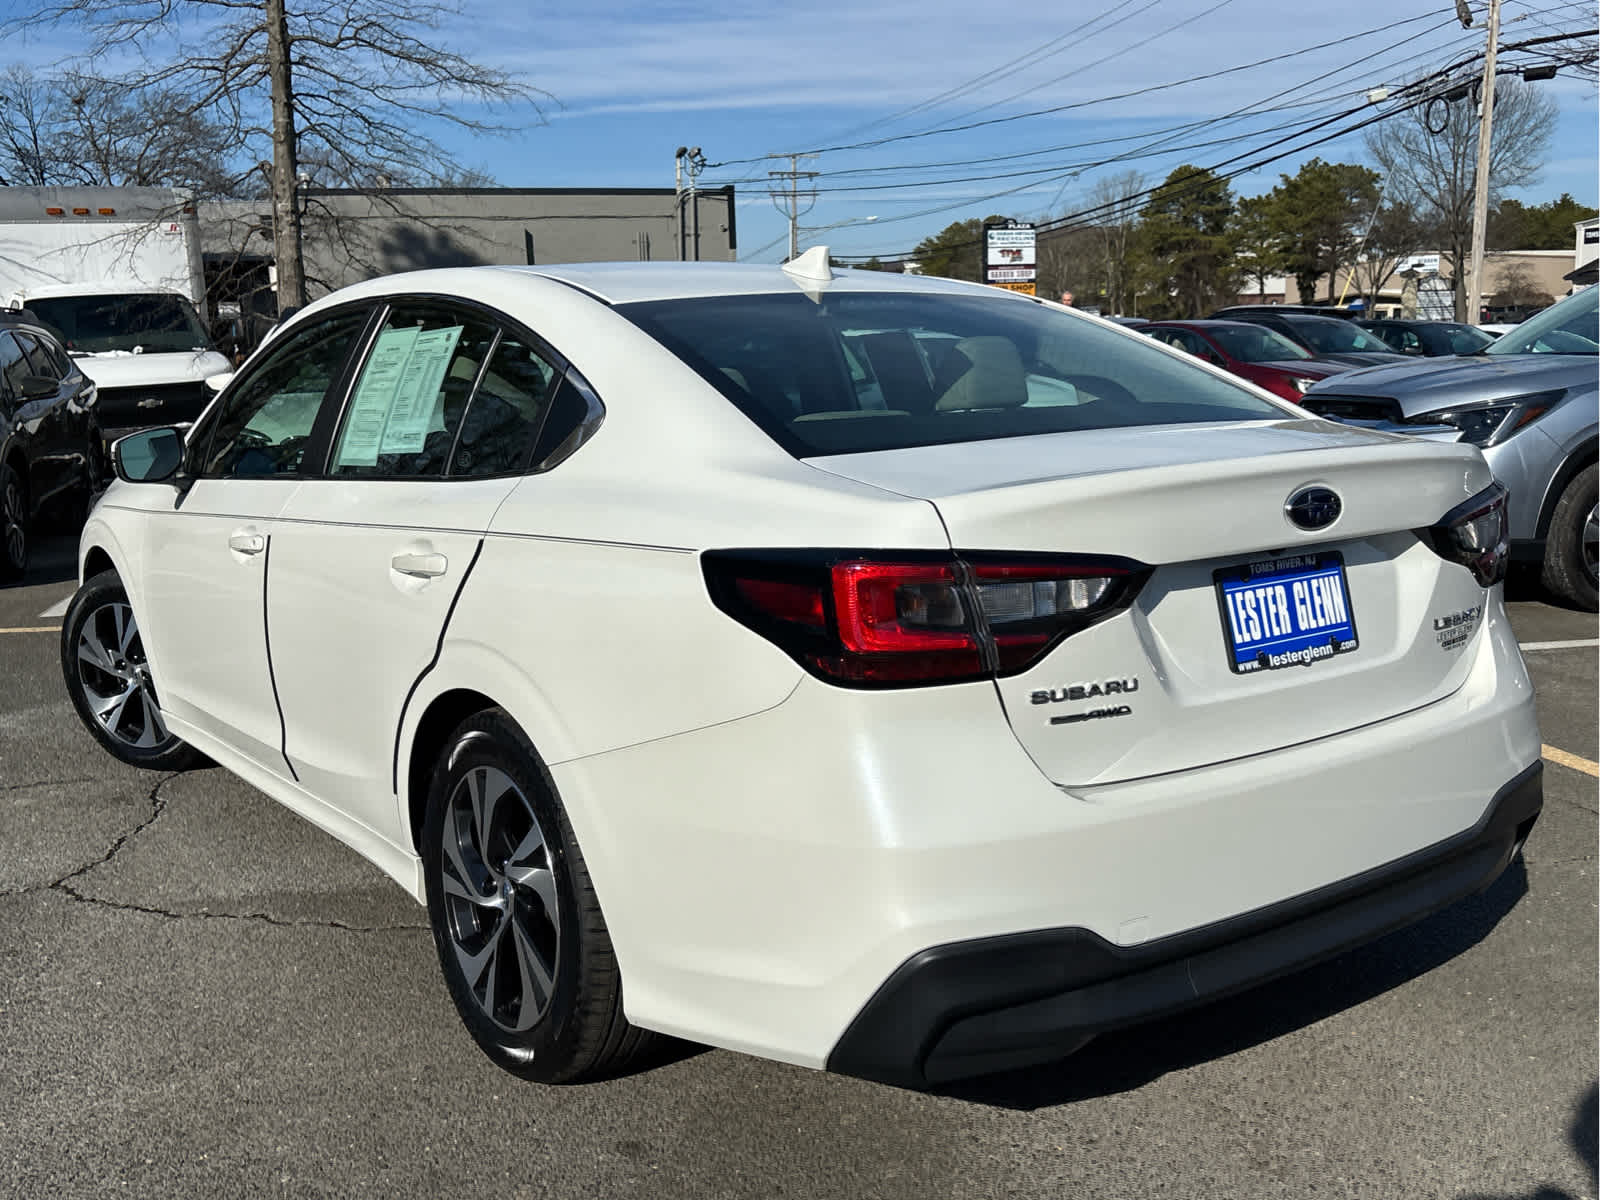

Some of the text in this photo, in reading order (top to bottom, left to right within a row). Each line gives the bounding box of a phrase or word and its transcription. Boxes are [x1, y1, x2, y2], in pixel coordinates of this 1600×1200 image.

[1016, 270, 1032, 278] SHOP
[1250, 555, 1317, 575] TOMS RIVER, NJ
[1226, 575, 1347, 644] LESTER GLENN
[1433, 604, 1481, 631] LEGACY
[1237, 639, 1357, 672] www. lesterglenn .com
[1031, 678, 1139, 705] SUBARU
[1087, 705, 1132, 720] AWD
